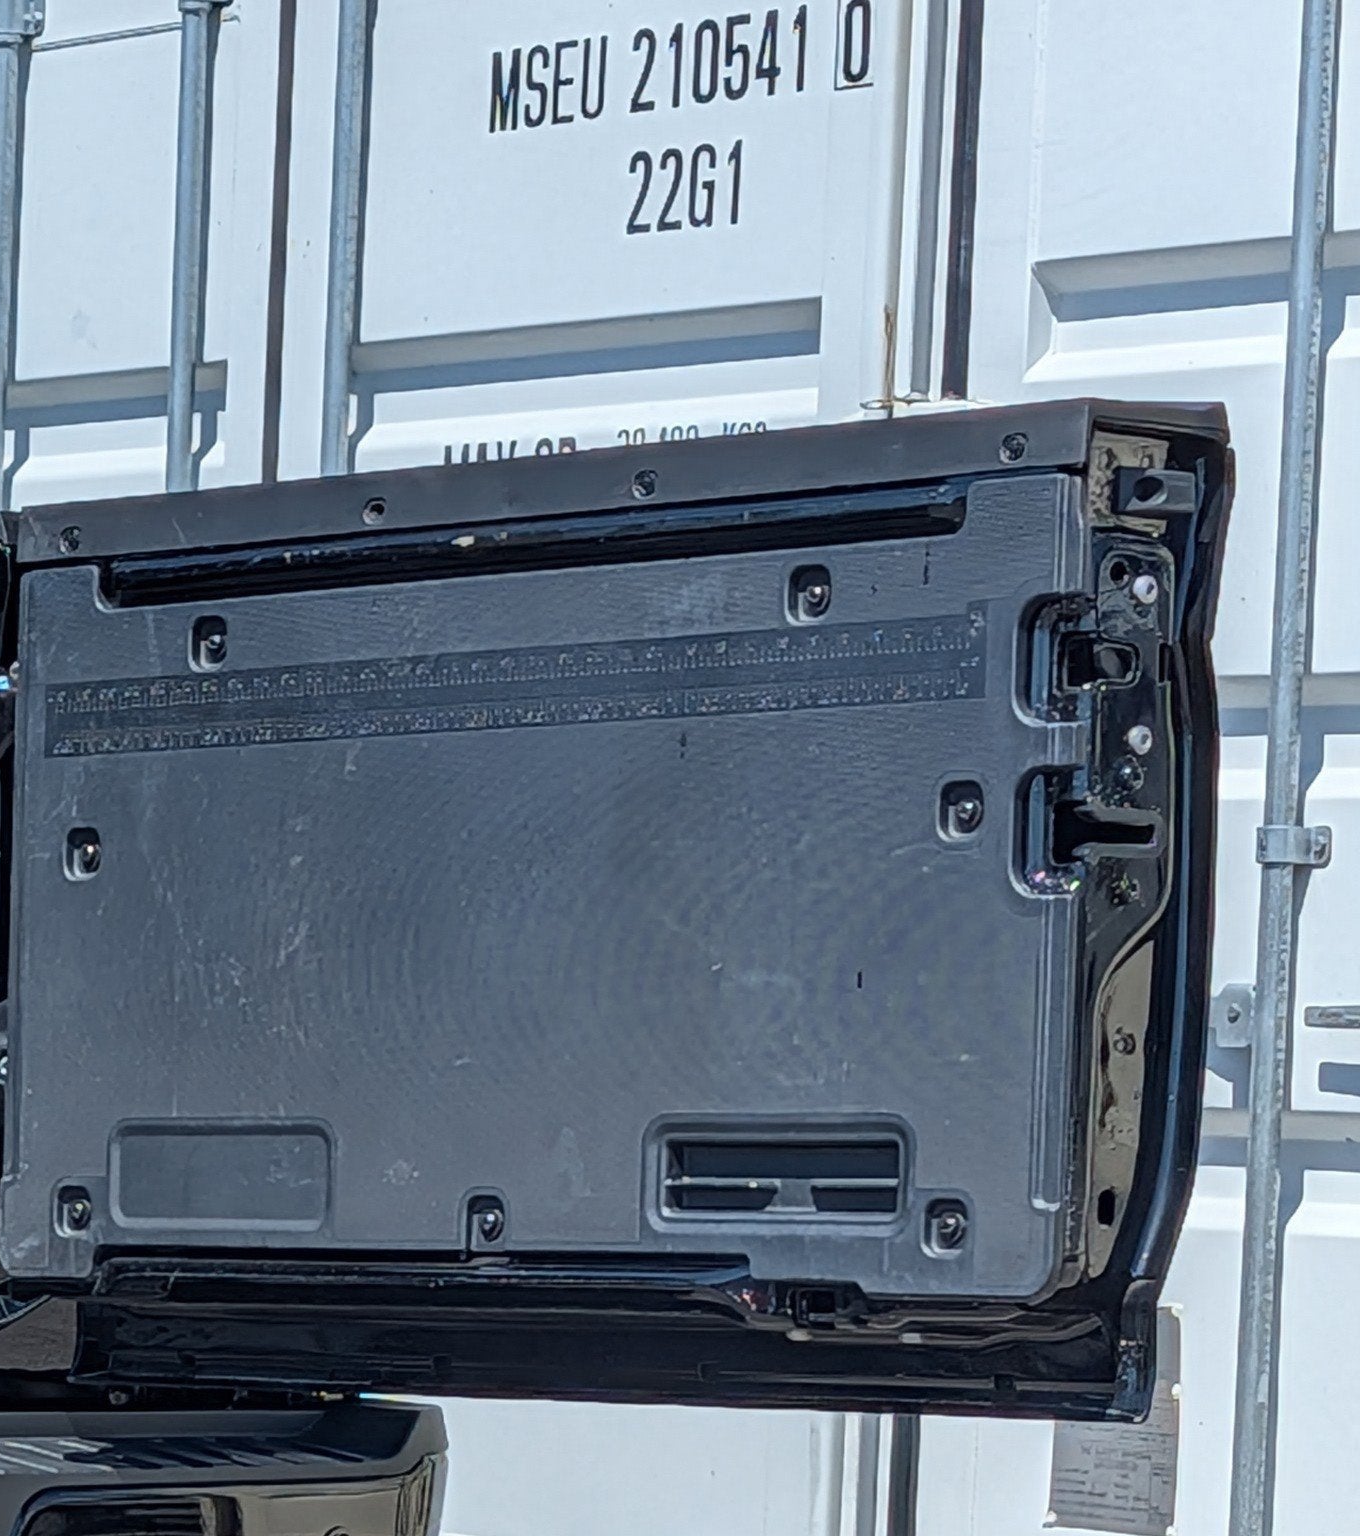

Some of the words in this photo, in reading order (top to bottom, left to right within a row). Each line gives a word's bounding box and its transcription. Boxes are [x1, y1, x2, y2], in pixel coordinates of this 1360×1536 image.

[489, 35, 608, 133] MSEU
[630, 4, 807, 113] 210541
[842, 0, 872, 83] 0
[626, 139, 743, 235] 22G1
